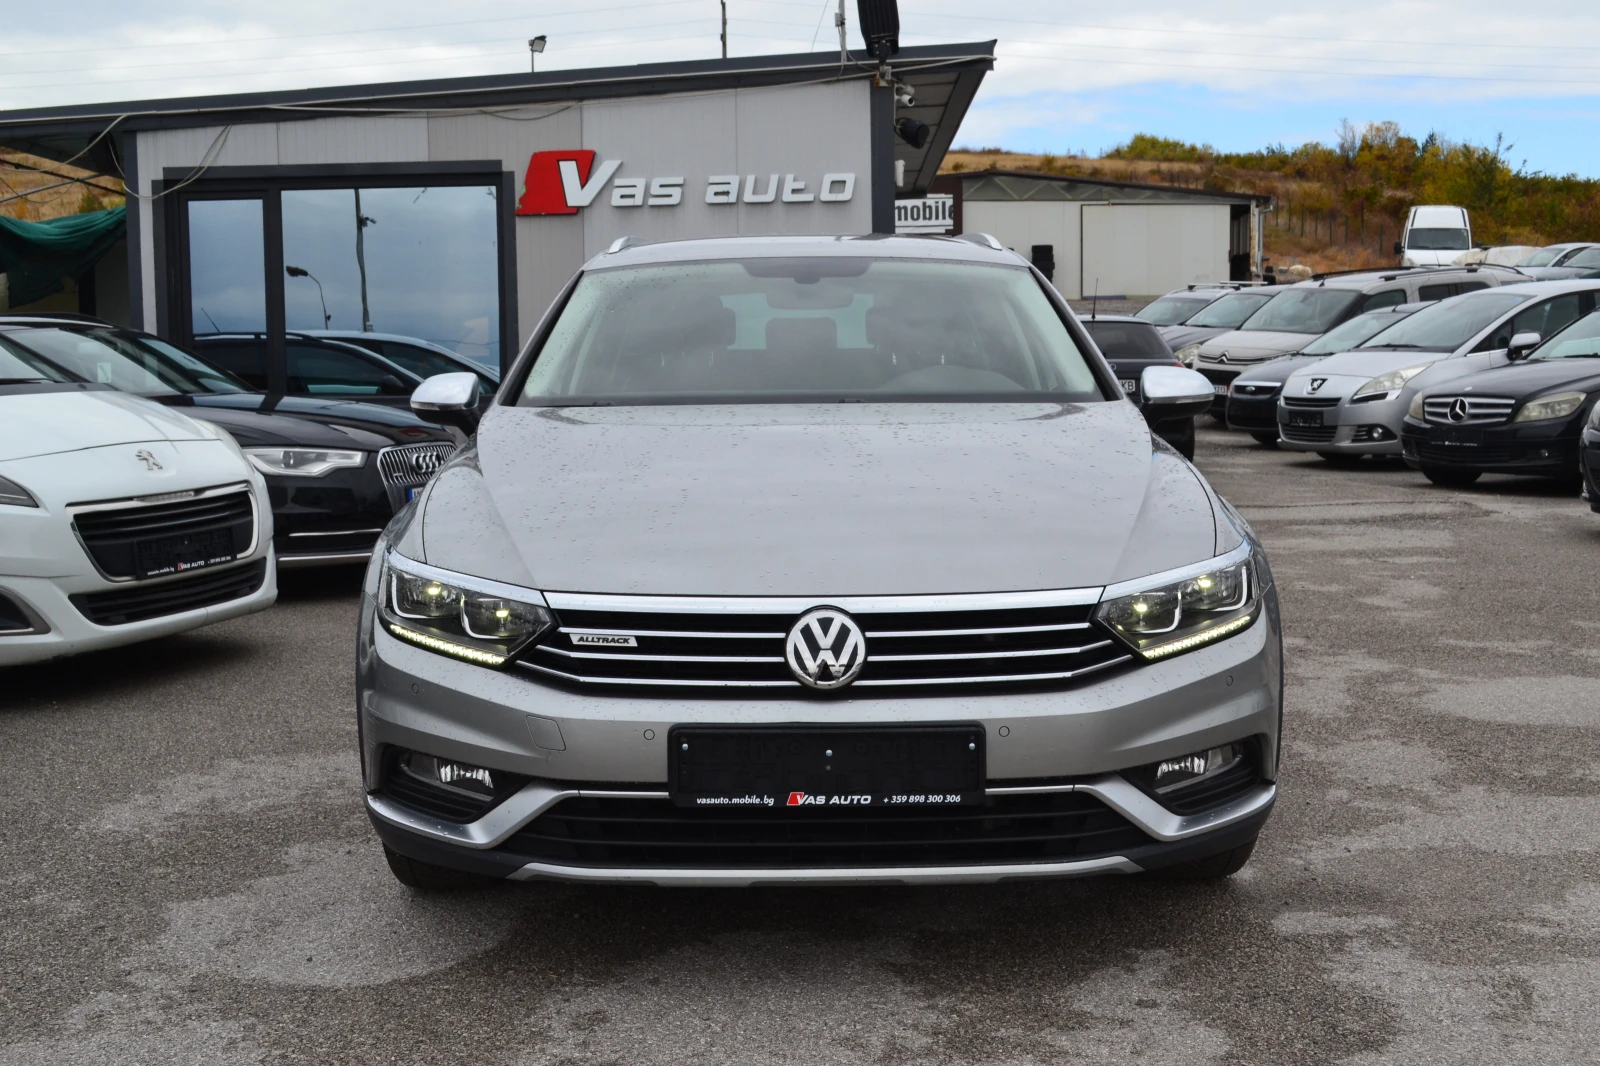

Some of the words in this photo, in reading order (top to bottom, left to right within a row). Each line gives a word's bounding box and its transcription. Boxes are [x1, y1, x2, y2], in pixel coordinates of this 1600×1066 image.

[576, 635, 631, 645] ALLTRACK
[696, 794, 775, 806] vasauto.mobile.bg
[796, 794, 826, 805] VAS
[828, 795, 872, 805] AUTO
[890, 795, 907, 804] 359
[908, 795, 925, 803] 898
[926, 794, 943, 803] 300
[944, 794, 961, 803] 306
